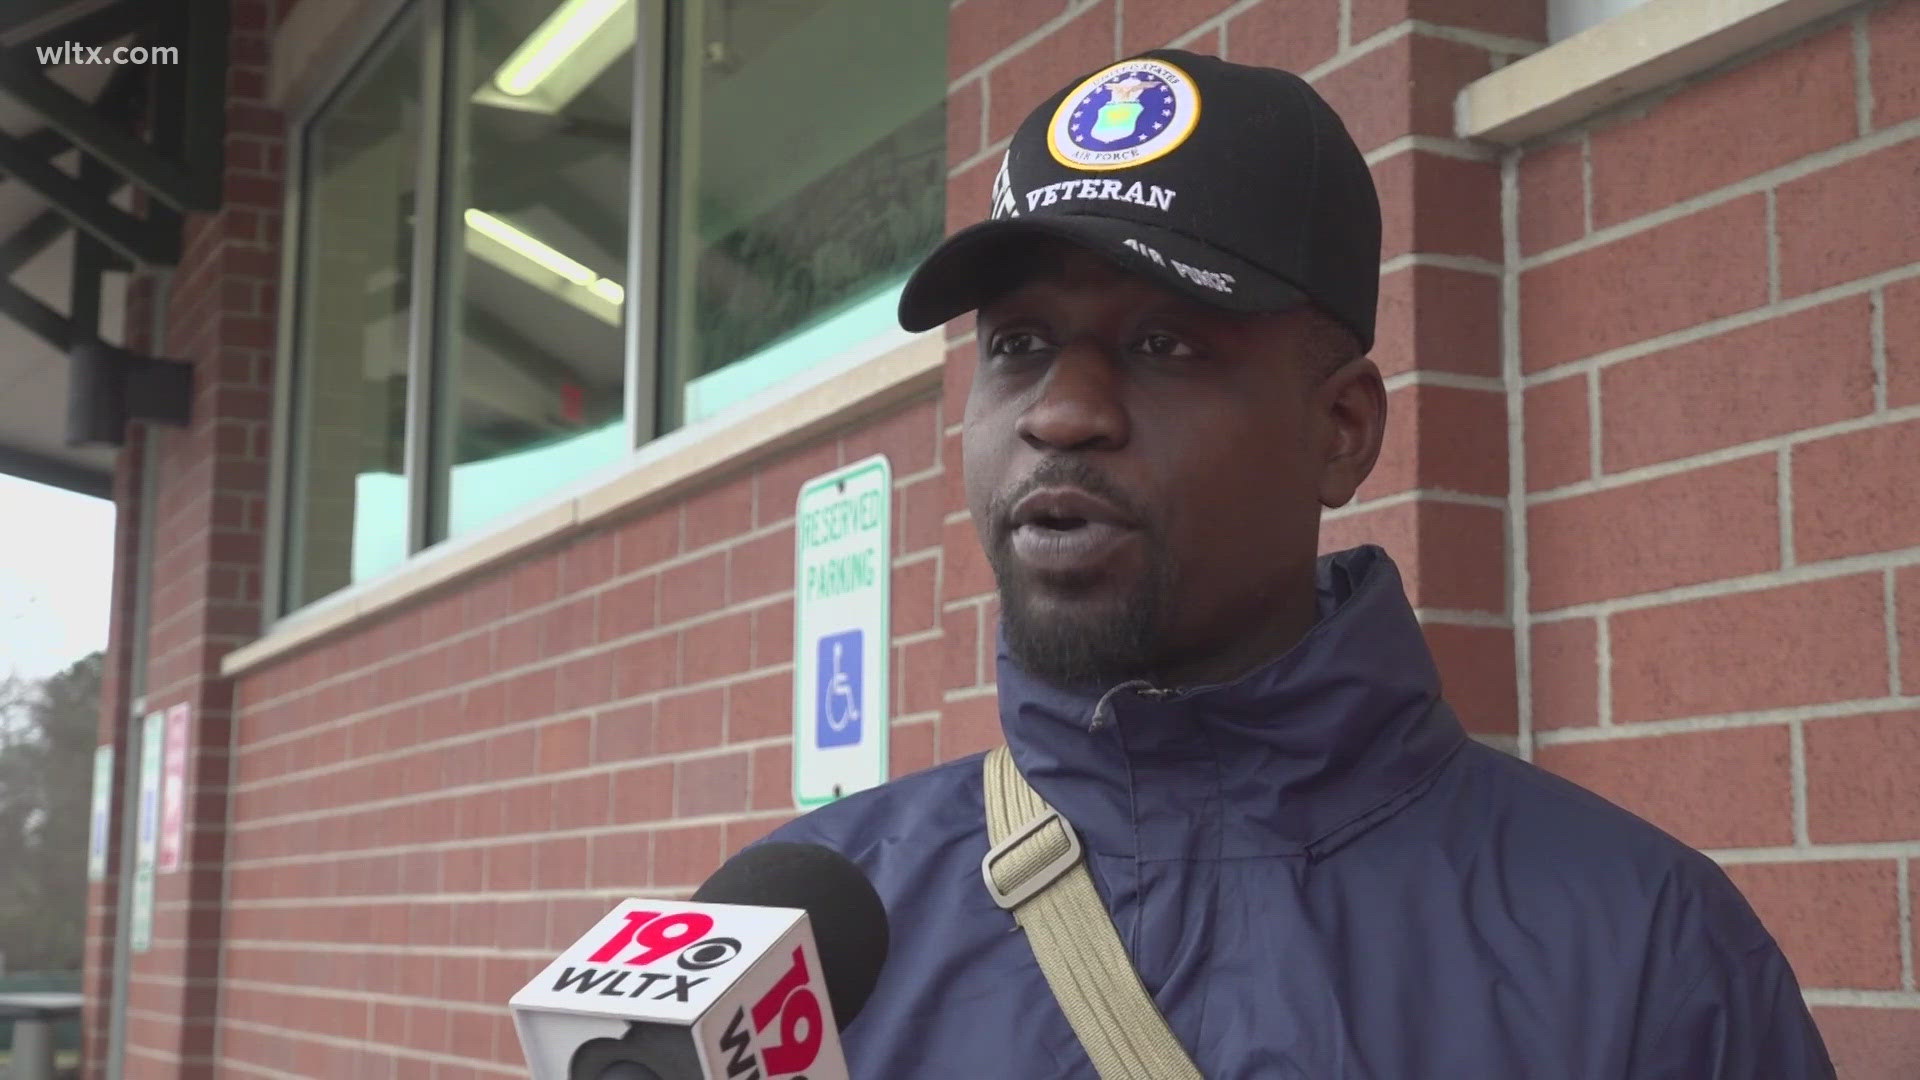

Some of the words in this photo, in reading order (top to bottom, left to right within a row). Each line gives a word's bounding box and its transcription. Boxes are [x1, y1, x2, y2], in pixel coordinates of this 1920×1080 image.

[1140, 63, 1180, 85] STATES
[1096, 149, 1140, 161] FORCE
[1025, 179, 1176, 212] VETERAN
[1122, 238, 1167, 268] AIR
[802, 489, 879, 547] RESERVED
[807, 548, 875, 600] PARKING
[587, 911, 714, 966] 19
[551, 966, 709, 1003] WLTX
[752, 944, 823, 1077] 19
